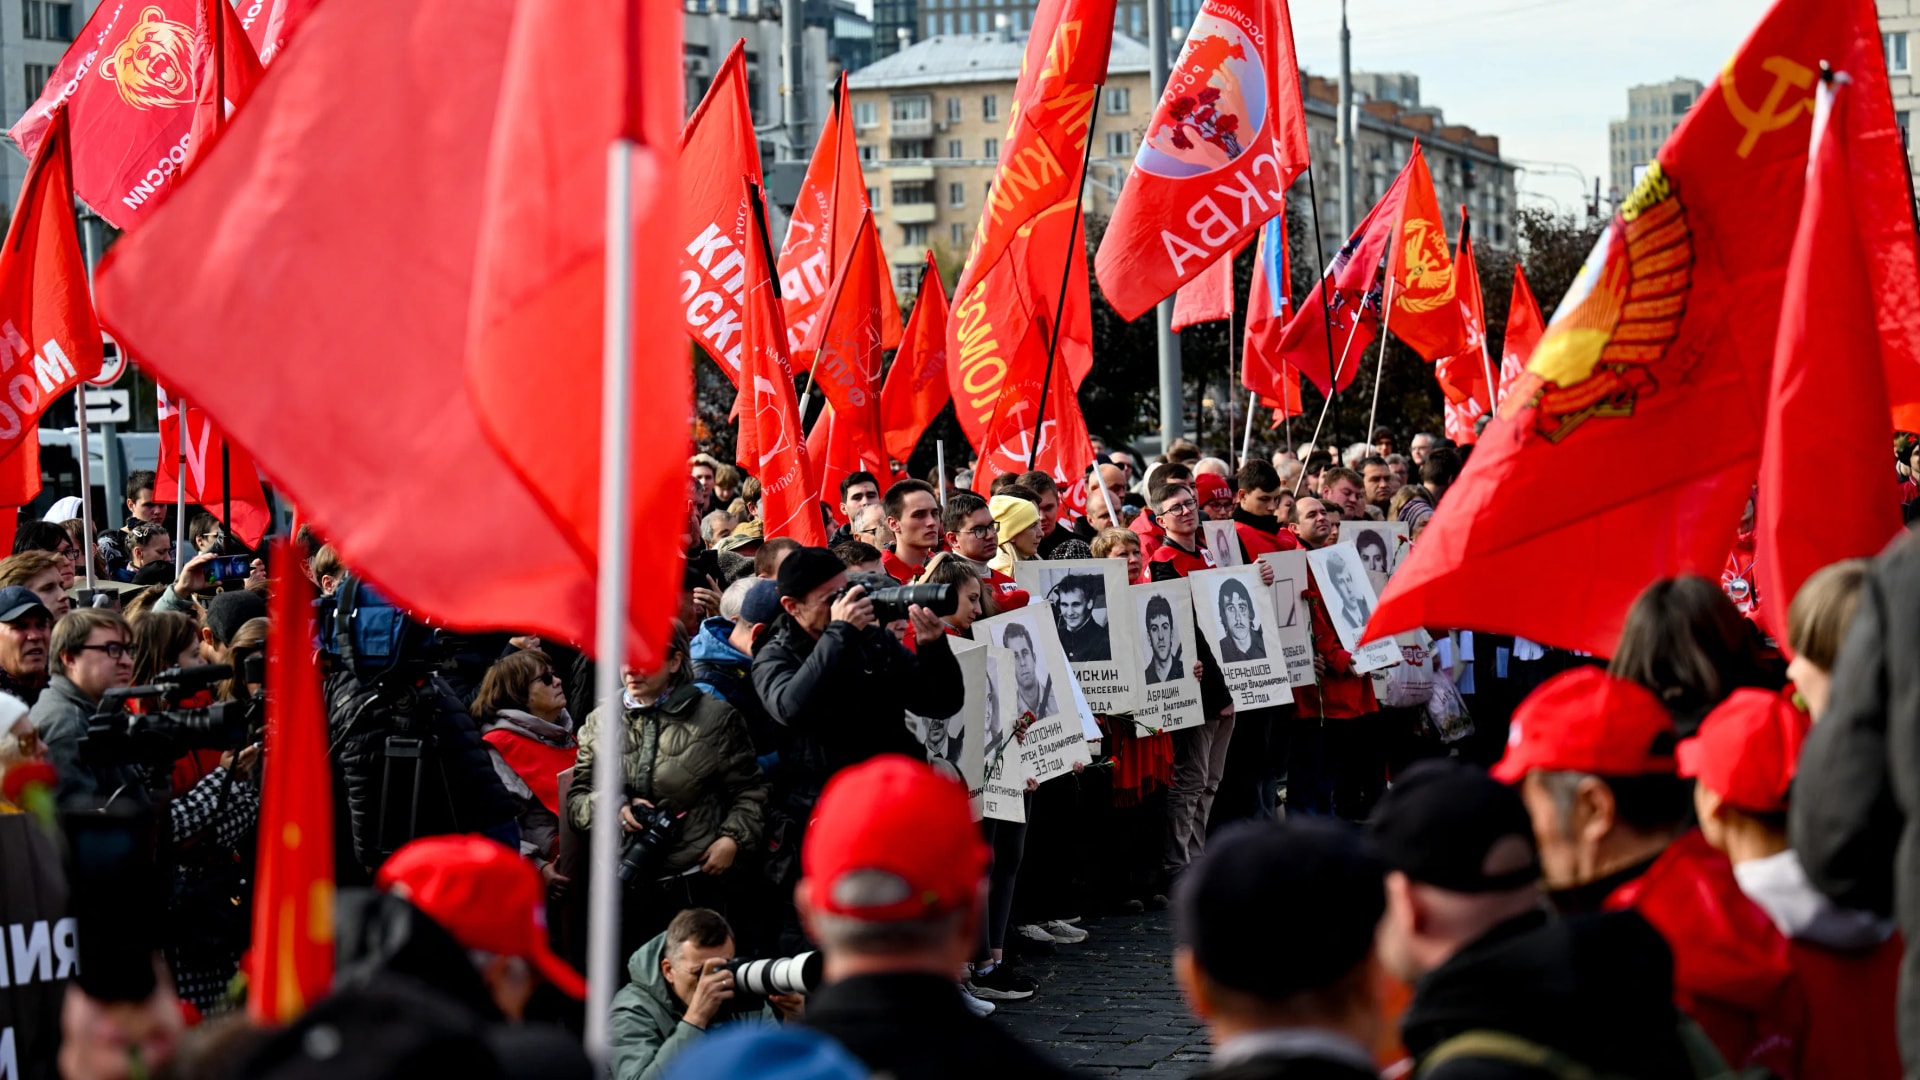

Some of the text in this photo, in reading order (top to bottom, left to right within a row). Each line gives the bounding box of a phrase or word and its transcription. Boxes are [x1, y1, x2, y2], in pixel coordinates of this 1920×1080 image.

[1223, 663, 1271, 680] ЧЕРНЫШОВ
[1146, 686, 1180, 703] АБРАШИН
[1241, 692, 1270, 705] 33 ГОДА
[1161, 713, 1183, 727] 28 ЛЕТ
[1032, 757, 1065, 777] 33 ГОДА
